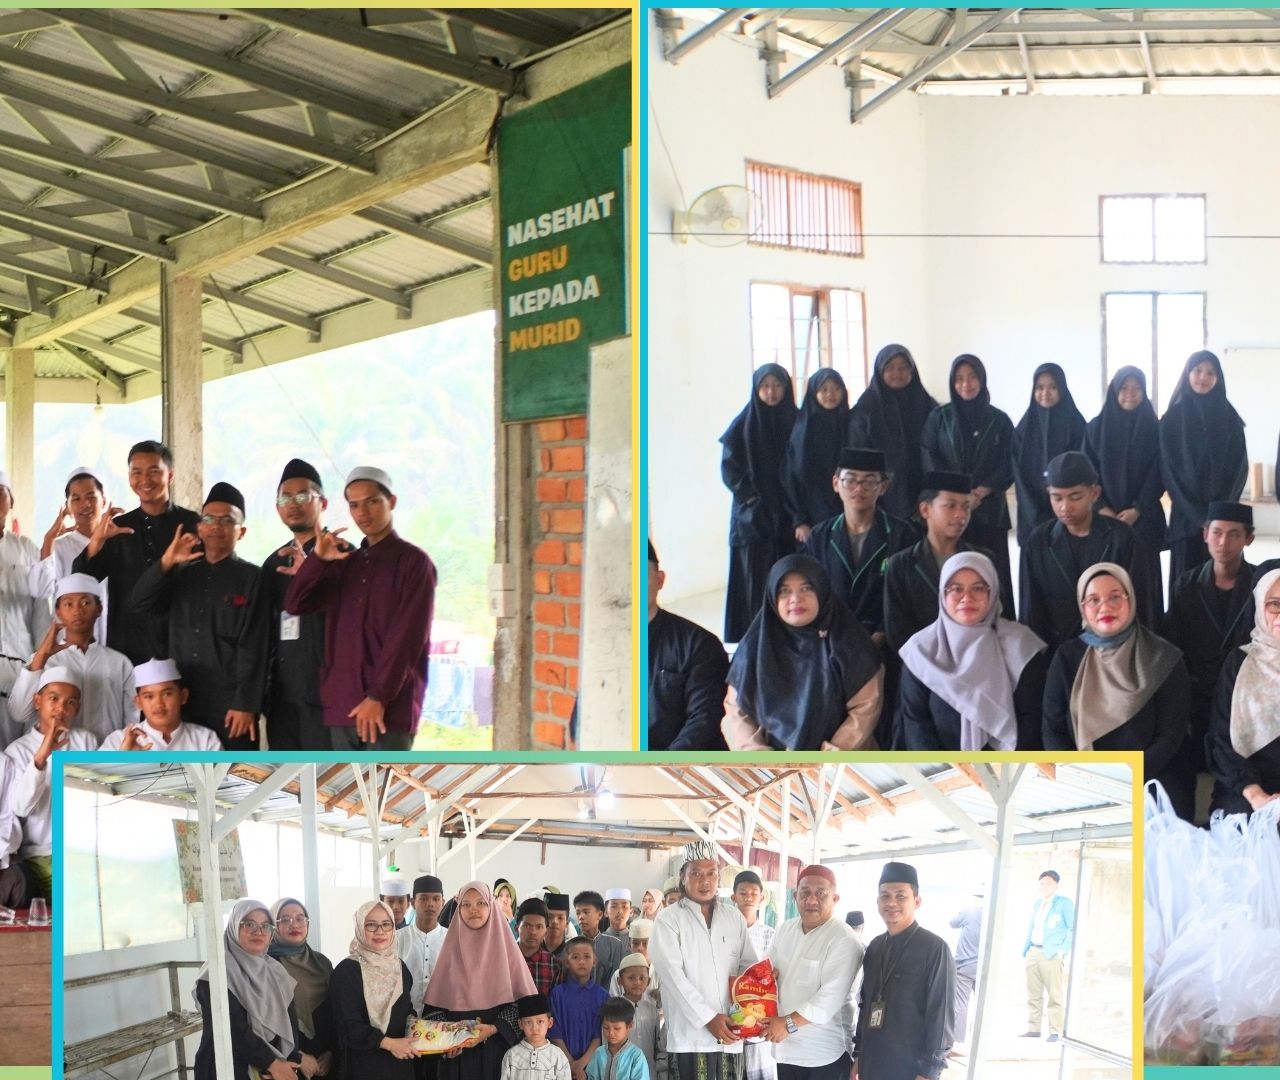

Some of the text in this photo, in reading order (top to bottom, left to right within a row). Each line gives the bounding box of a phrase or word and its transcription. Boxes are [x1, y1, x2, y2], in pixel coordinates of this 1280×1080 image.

[508, 191, 615, 247] NASEHAT
[508, 245, 569, 282] GURU
[509, 274, 600, 317] KEPADA
[509, 317, 581, 353] MURID
